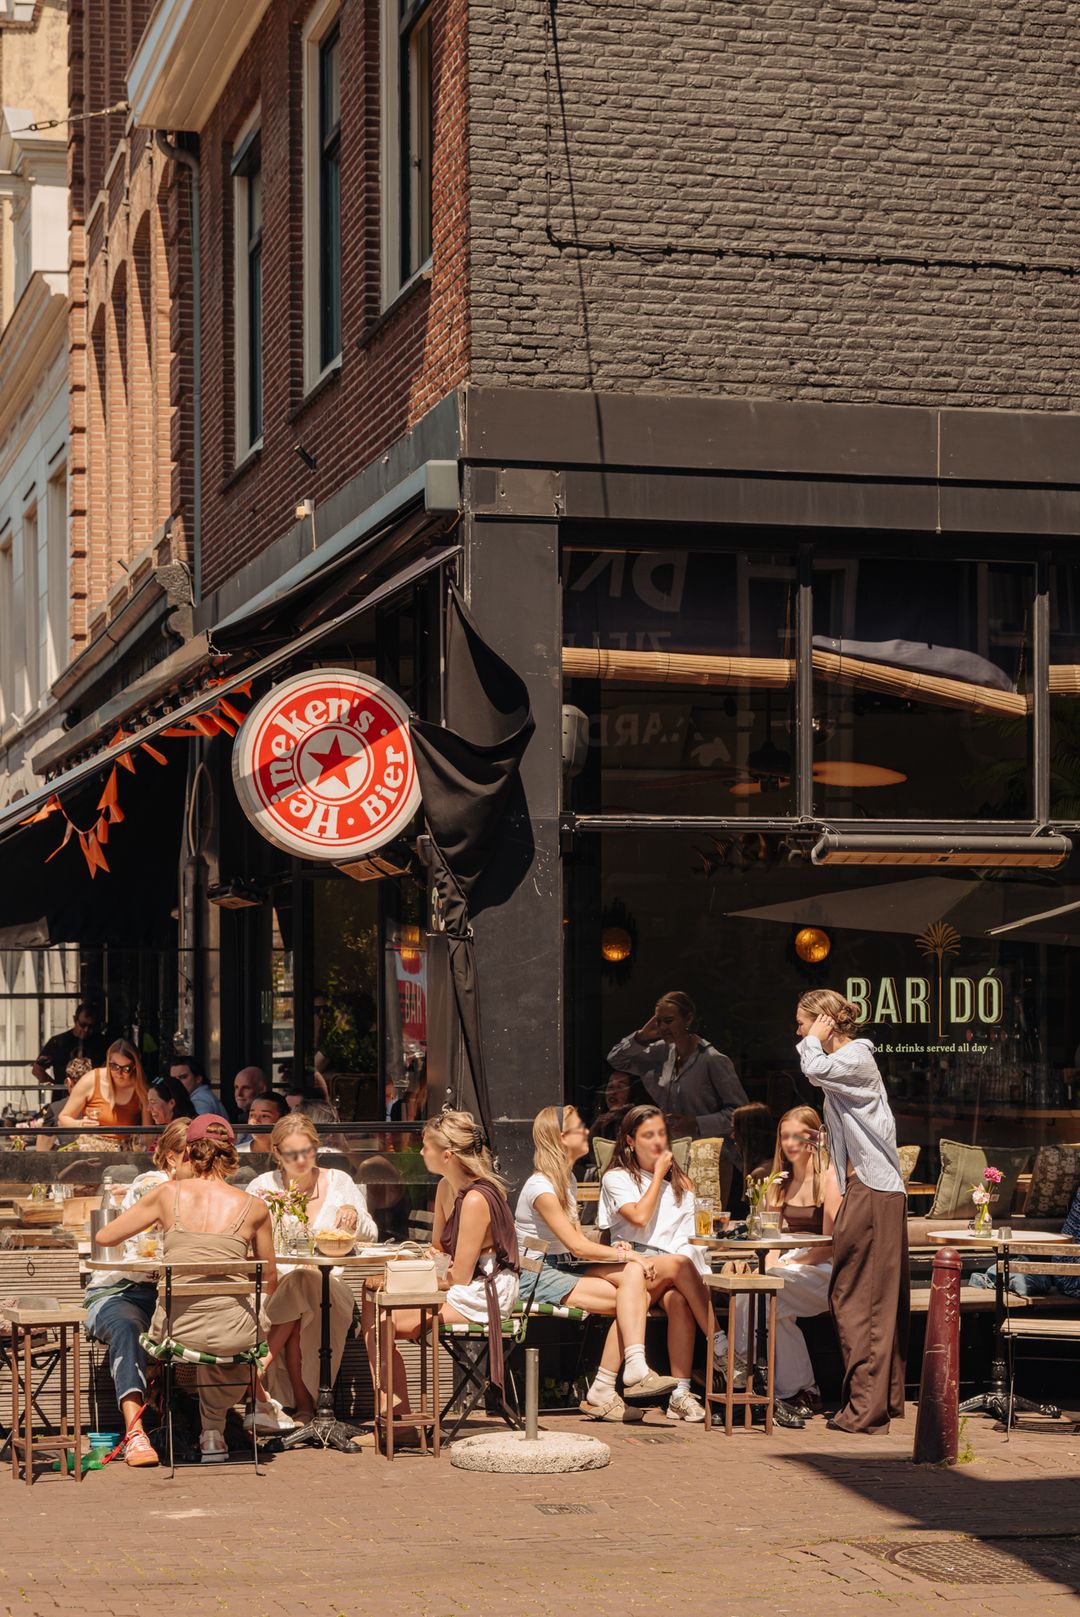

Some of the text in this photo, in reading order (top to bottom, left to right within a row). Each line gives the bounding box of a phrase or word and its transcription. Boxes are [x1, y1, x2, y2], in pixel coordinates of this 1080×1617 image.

[269, 697, 404, 838] Heineken's Bier
[846, 967, 1004, 1024] BAR DÓ
[895, 1043, 925, 1053] drinks
[926, 1043, 956, 1052] served
[957, 1043, 969, 1052] all
[971, 1042, 988, 1054] day
